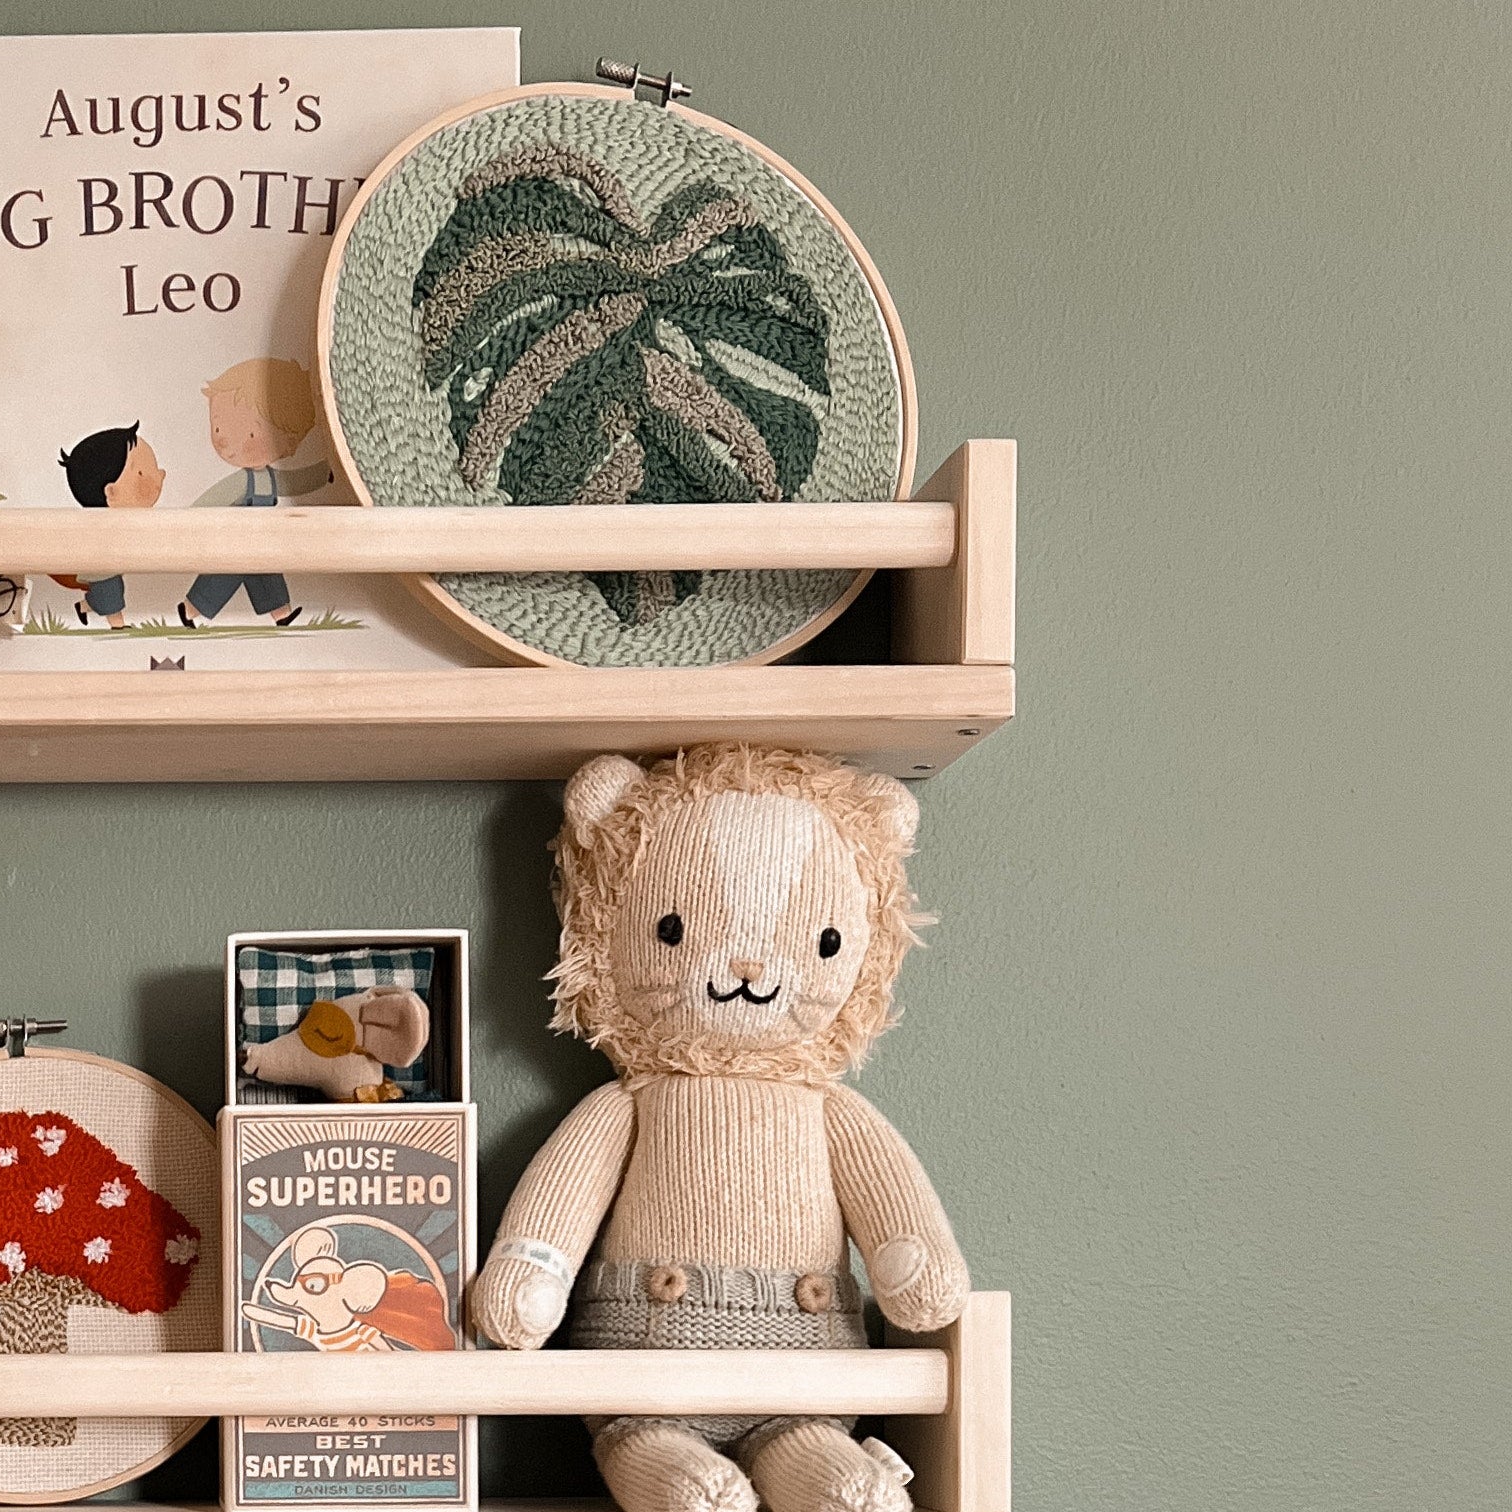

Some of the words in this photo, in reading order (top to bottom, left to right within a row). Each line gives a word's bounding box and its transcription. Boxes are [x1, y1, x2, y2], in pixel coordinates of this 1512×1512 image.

[40, 76, 322, 148] August's
[77, 170, 365, 237] BROTH
[120, 264, 241, 316] Leo
[303, 1146, 397, 1173] MOUSE
[246, 1174, 452, 1208] SUPERHERO
[265, 1416, 339, 1428] AVERAGE
[347, 1416, 368, 1428] 40
[377, 1415, 436, 1427] STICKS
[315, 1434, 387, 1449] BEST
[245, 1454, 340, 1478] SAFETY
[345, 1453, 456, 1478] MATCHES
[294, 1485, 348, 1496] DANISH
[354, 1484, 408, 1495] DESIGN
